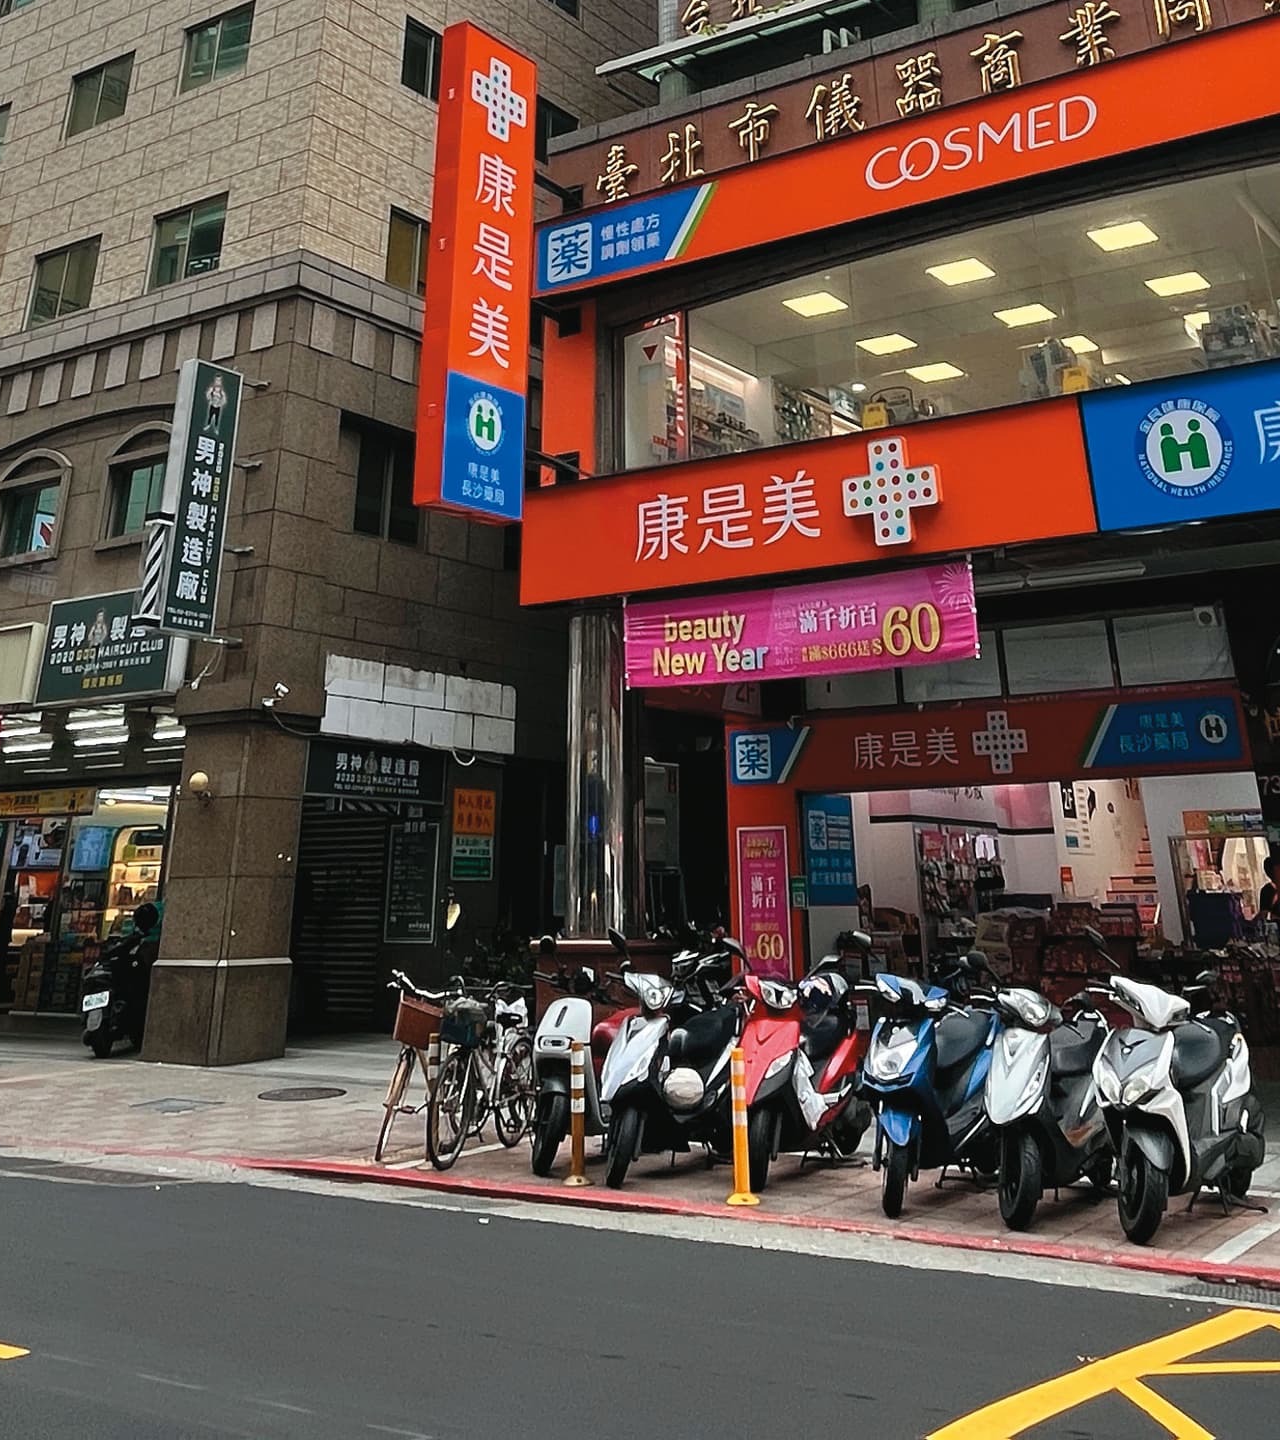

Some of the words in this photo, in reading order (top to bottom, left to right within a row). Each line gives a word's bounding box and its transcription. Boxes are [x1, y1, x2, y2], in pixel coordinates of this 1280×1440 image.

[864, 93, 1099, 192] COSMED
[468, 152, 518, 369] 康是美
[468, 462, 501, 486] 康是美
[1138, 453, 1168, 493] NATIONAL
[1170, 485, 1207, 497] HEALTH
[1207, 439, 1233, 489] INSURANCE
[462, 480, 506, 506] 長沙藥局
[175, 435, 217, 601] 男神製造廠
[635, 469, 822, 564] 康是美
[205, 506, 217, 564] HAIRCUT
[199, 569, 210, 604] CLUB
[664, 613, 746, 644] beauty
[799, 602, 877, 634] 滿千折百
[882, 601, 941, 656] 60
[97, 641, 139, 659] HAIRCUT
[140, 638, 164, 653] CLUB
[653, 644, 711, 677] New
[712, 641, 768, 673] Year
[854, 726, 960, 770] 康是美
[1119, 730, 1190, 754] 長沙藥局
[756, 933, 785, 961] 60
